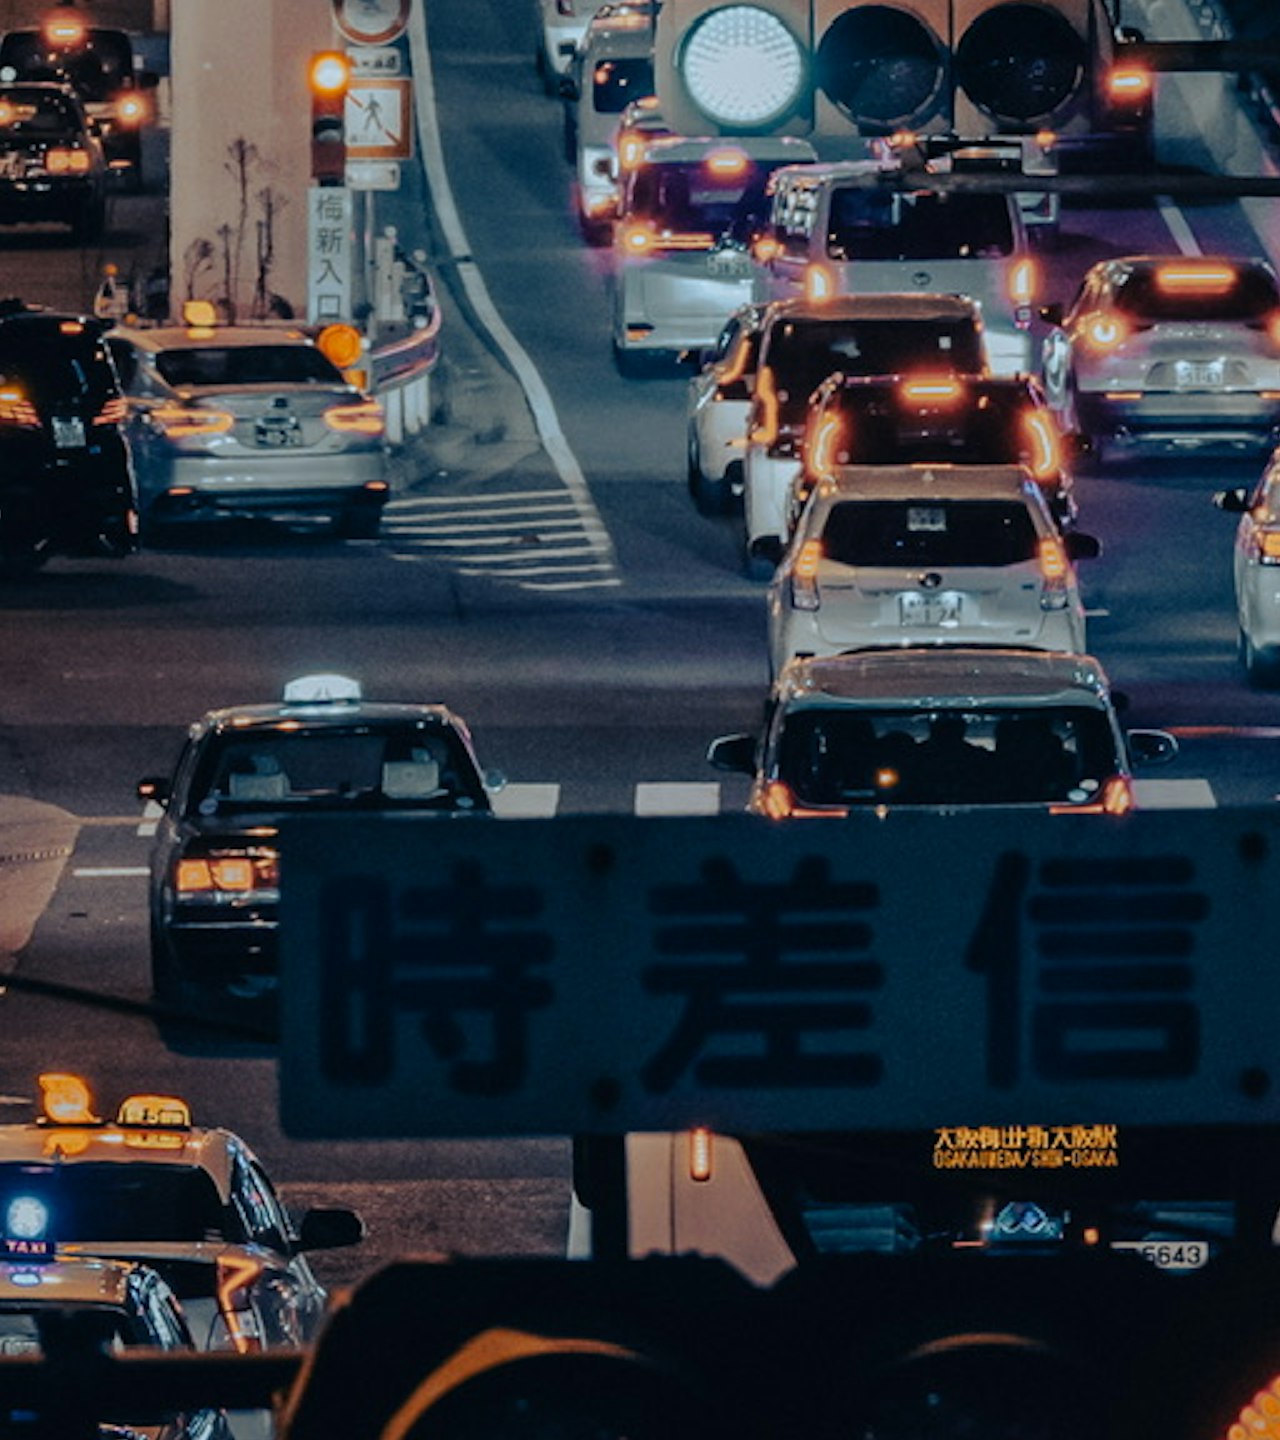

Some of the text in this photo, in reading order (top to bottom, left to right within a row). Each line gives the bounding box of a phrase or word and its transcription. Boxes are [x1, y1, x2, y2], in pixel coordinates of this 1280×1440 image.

[314, 193, 345, 318] 梅新入口
[5, 1239, 47, 1254] TAXI
